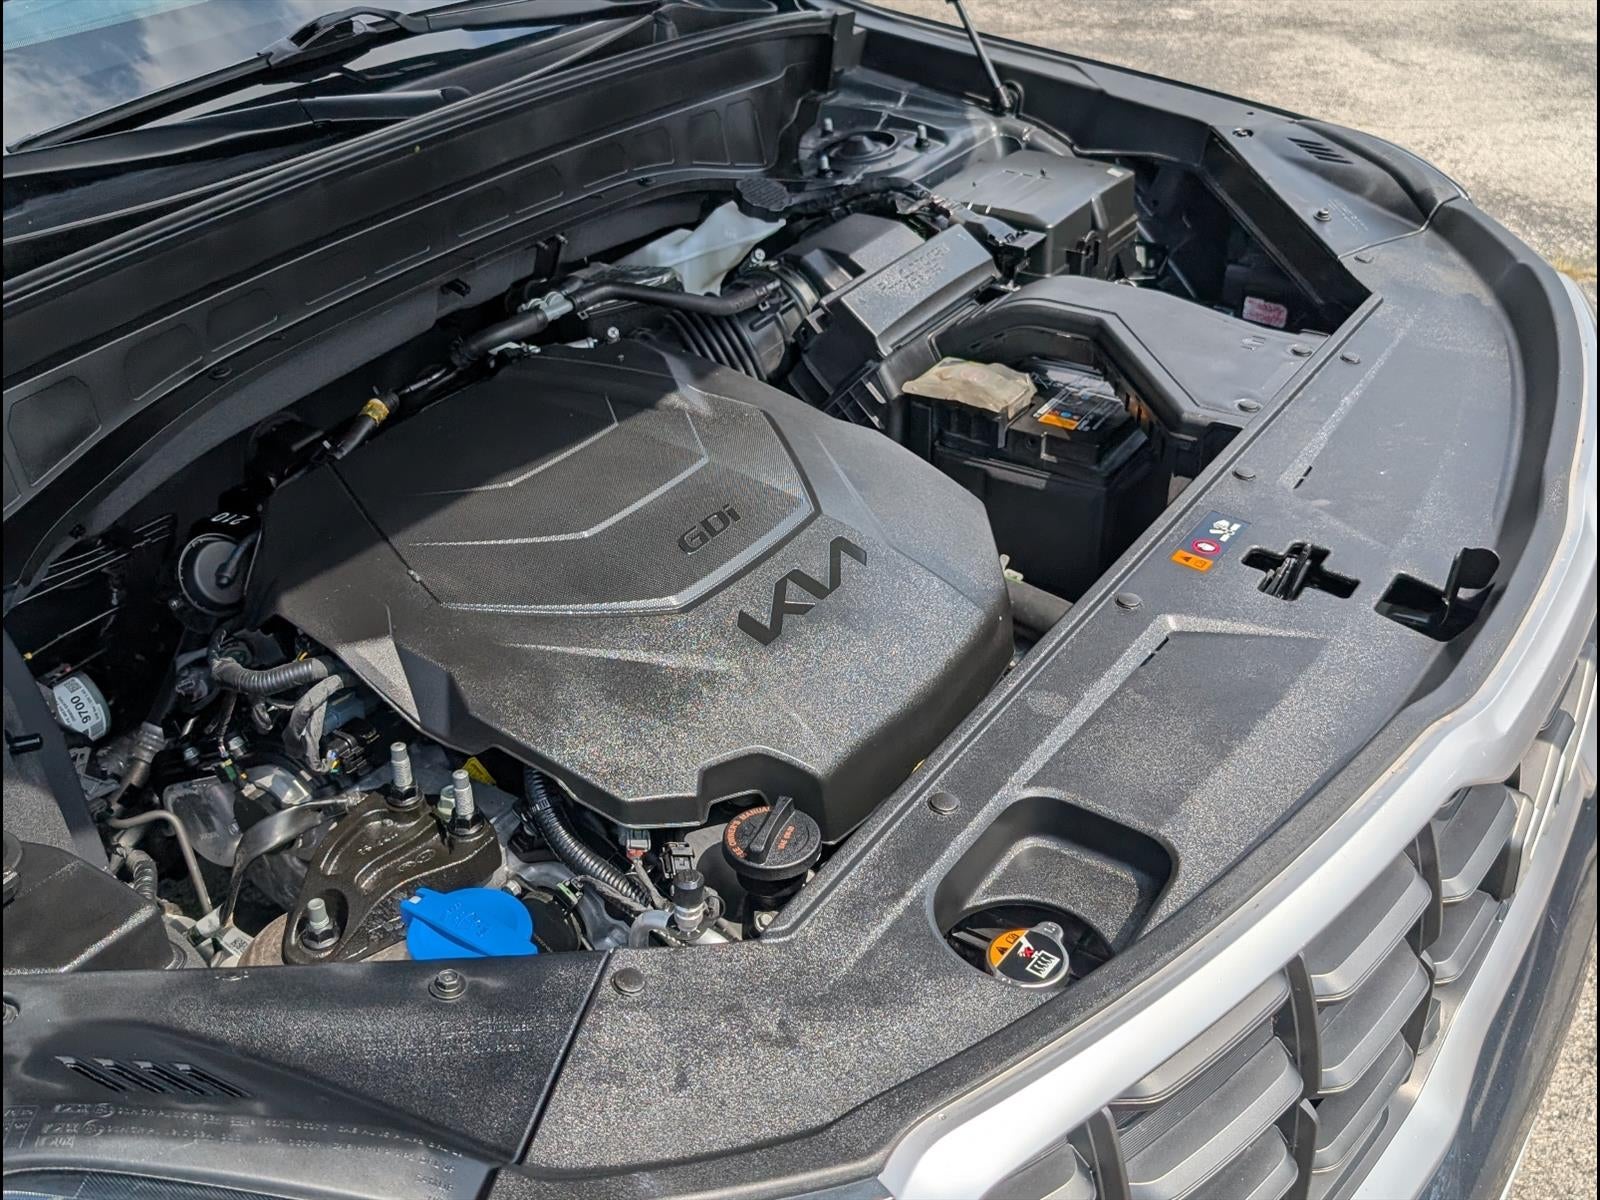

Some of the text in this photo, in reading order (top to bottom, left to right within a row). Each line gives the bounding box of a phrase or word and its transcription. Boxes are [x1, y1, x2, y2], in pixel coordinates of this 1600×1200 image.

[211, 511, 251, 525] 210
[678, 504, 741, 555] GDi
[70, 695, 92, 724] 9700
[731, 846, 748, 858] SEE
